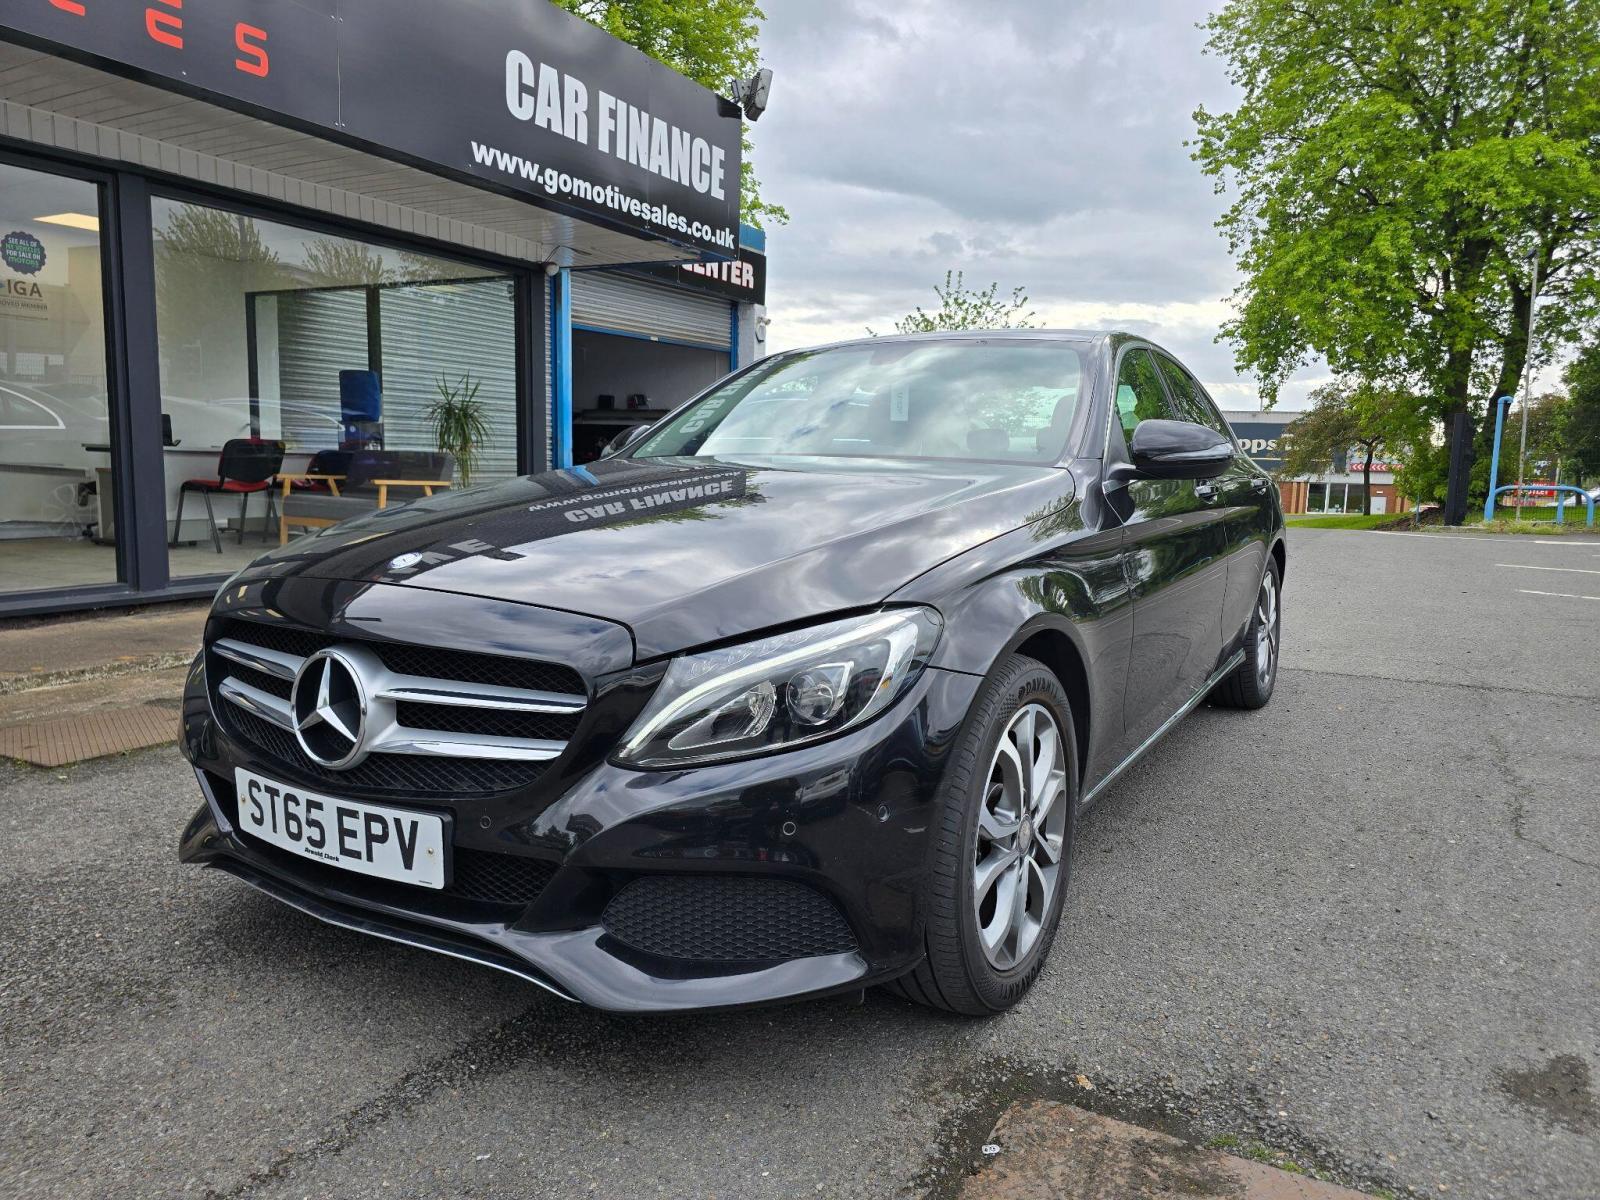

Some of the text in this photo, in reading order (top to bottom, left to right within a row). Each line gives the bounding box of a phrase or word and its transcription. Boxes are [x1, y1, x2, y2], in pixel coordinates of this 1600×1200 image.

[505, 49, 726, 201] CAR FINANCE
[470, 140, 735, 250] www.gomotivesales.co.uk
[7, 279, 43, 298] IGA
[248, 779, 419, 871] ST65 EPV
